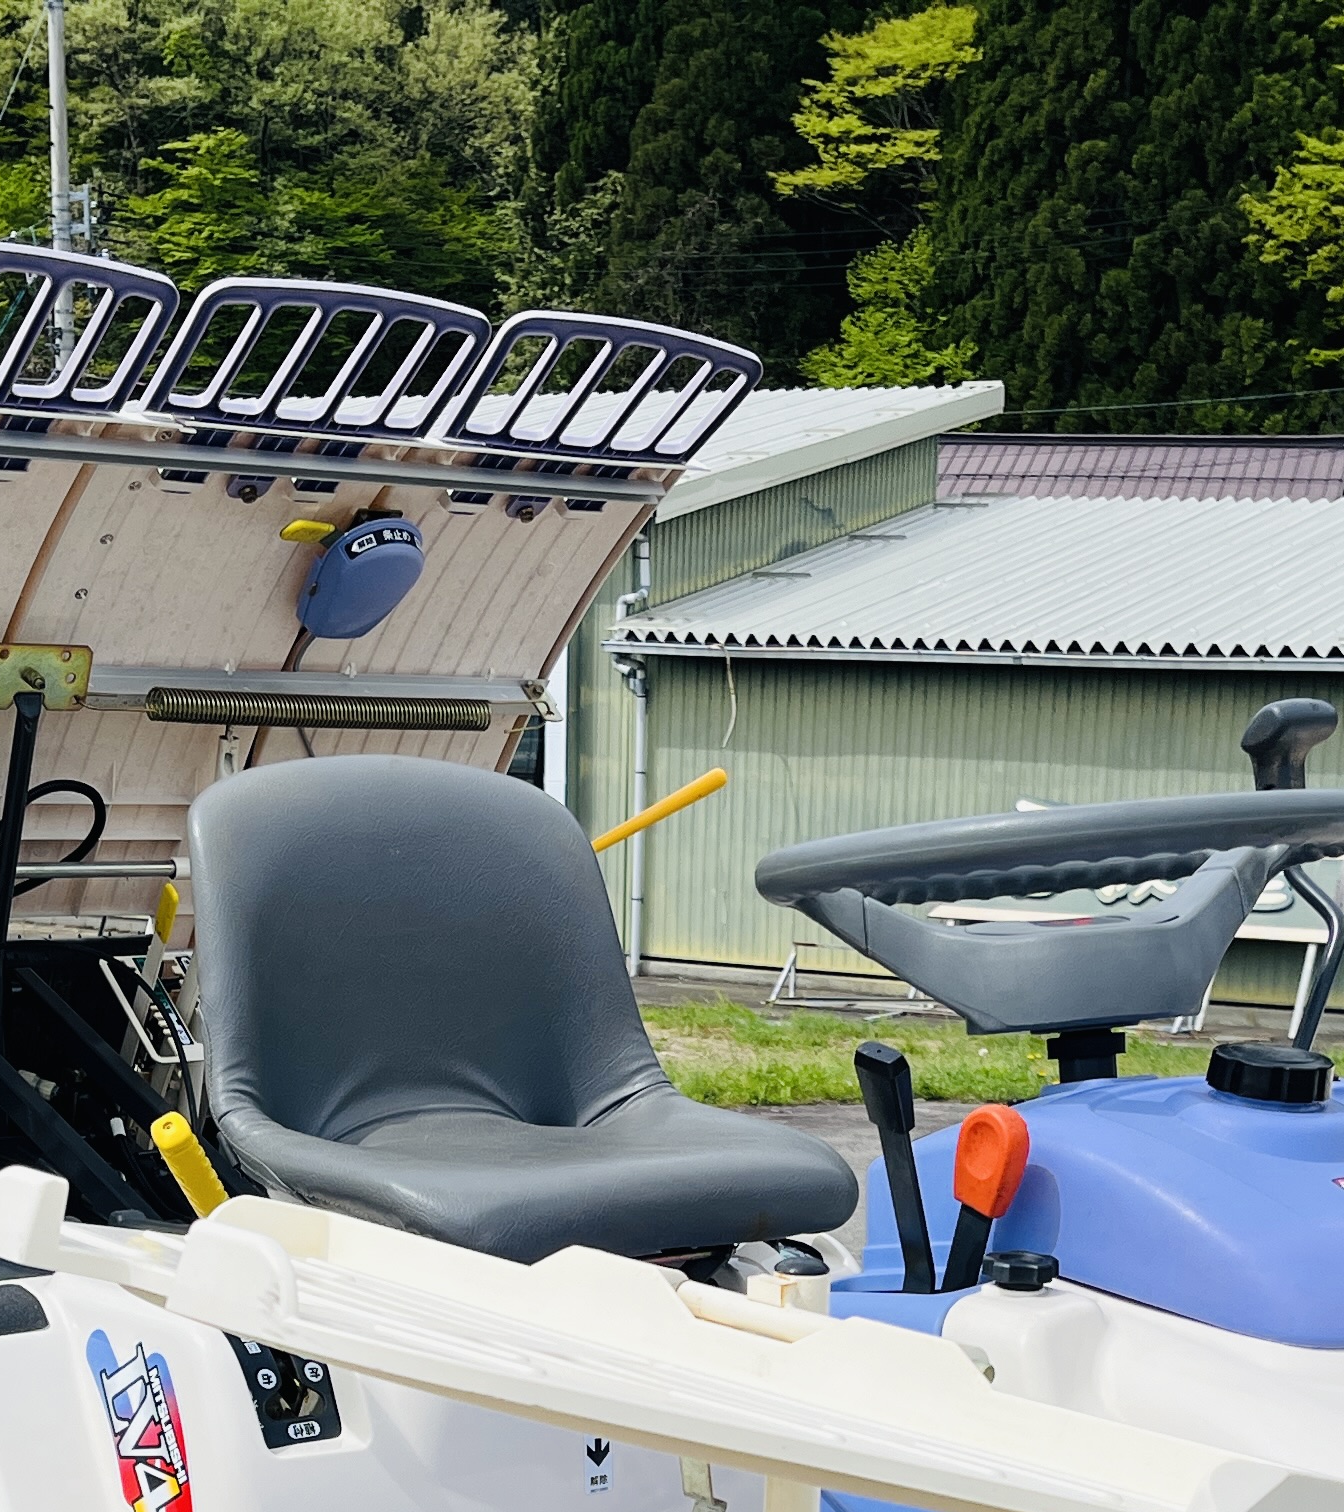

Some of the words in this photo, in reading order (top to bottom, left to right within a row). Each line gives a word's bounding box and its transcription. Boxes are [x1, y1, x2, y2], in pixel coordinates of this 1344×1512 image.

[382, 529, 411, 541] 条止め
[148, 1365, 189, 1485] MITSUBISHI
